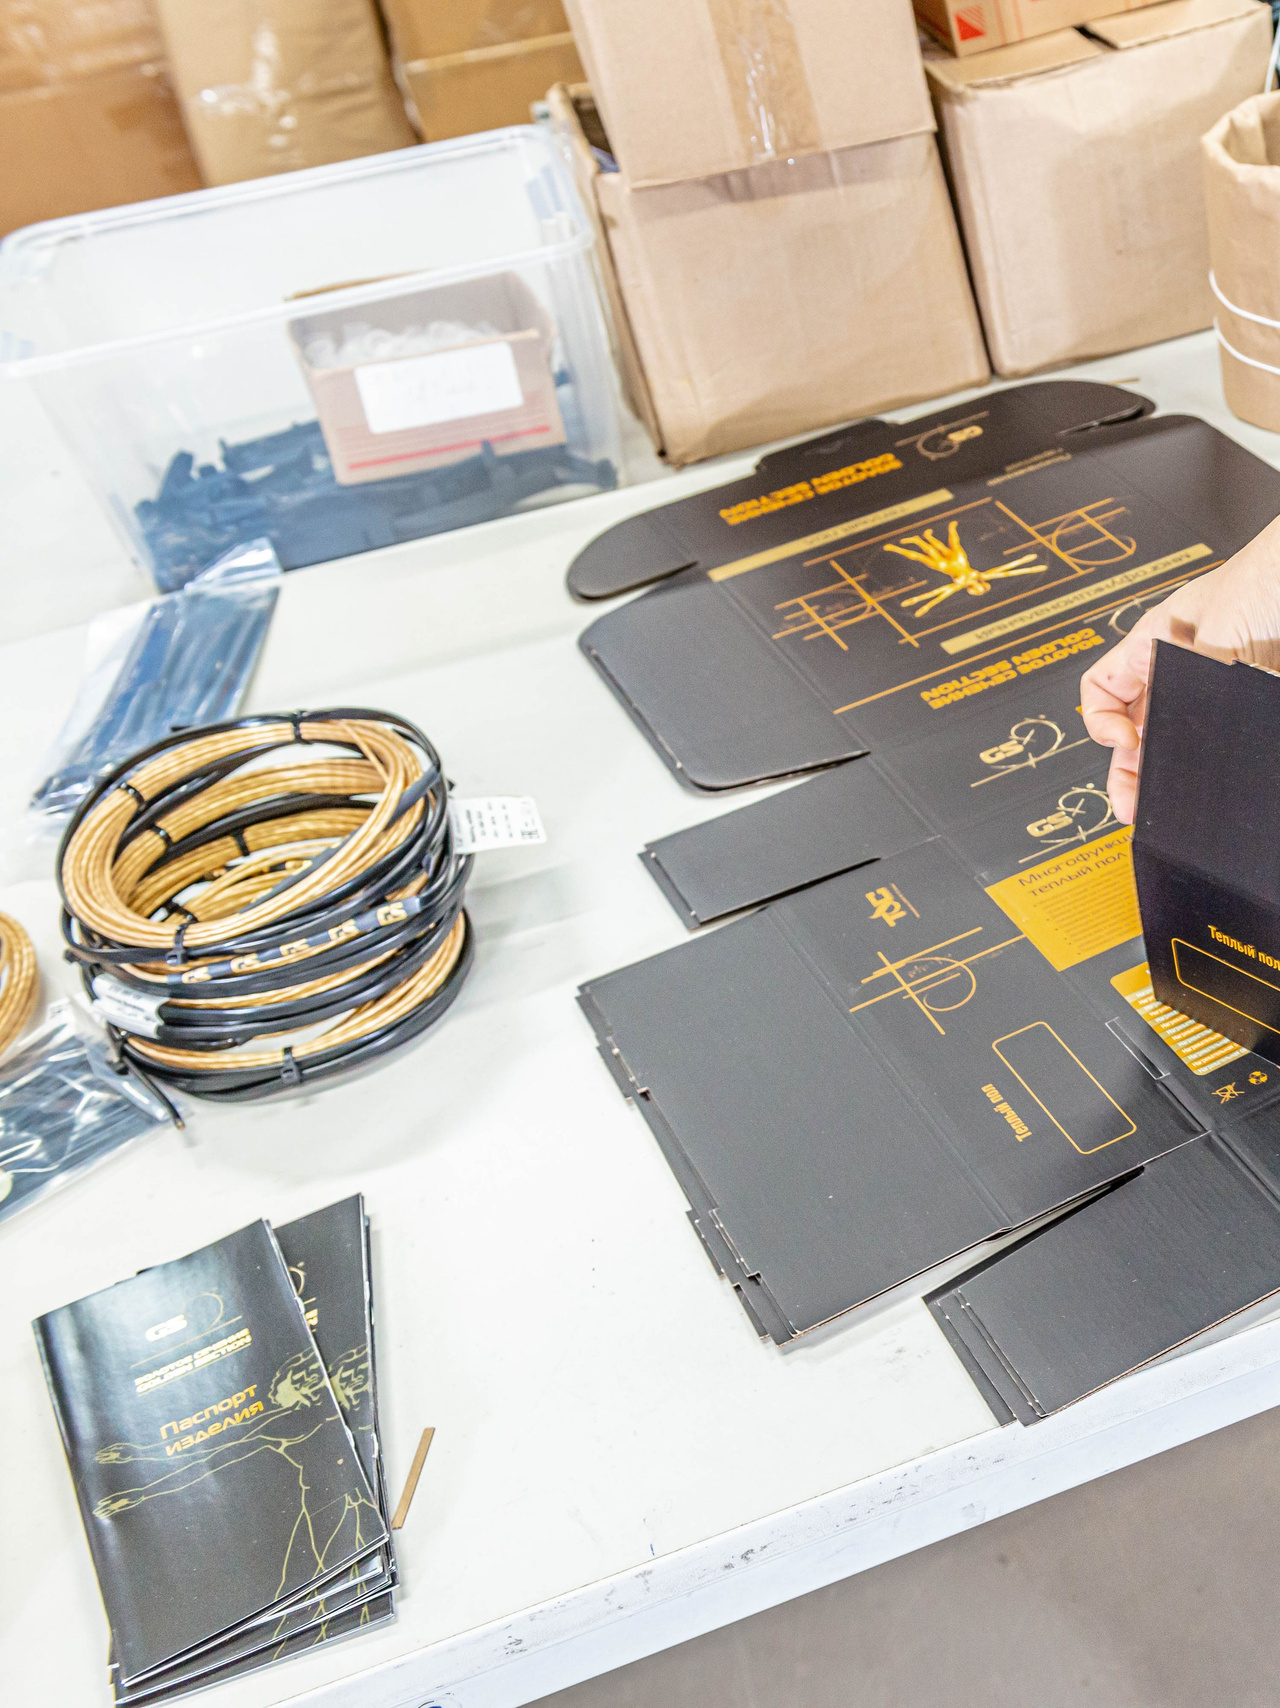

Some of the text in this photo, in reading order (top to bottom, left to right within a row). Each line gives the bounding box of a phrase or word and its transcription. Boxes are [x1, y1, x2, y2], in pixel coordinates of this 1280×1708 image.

[920, 627, 1096, 701] GOLDEN SECTION
[928, 669, 1018, 709] СЕЧЕНИЕ
[979, 739, 1025, 764] GS
[1026, 811, 1073, 837] GS
[1029, 852, 1127, 897] теплый пол
[328, 918, 360, 941] GS
[376, 901, 407, 926] GS
[1207, 924, 1257, 959] Теплый
[981, 1083, 1033, 1142] Теплый пол
[145, 1314, 188, 1342] GS
[194, 1334, 252, 1368] SECTION
[159, 1384, 258, 1440] Паспорт
[165, 1400, 265, 1457] изделия
